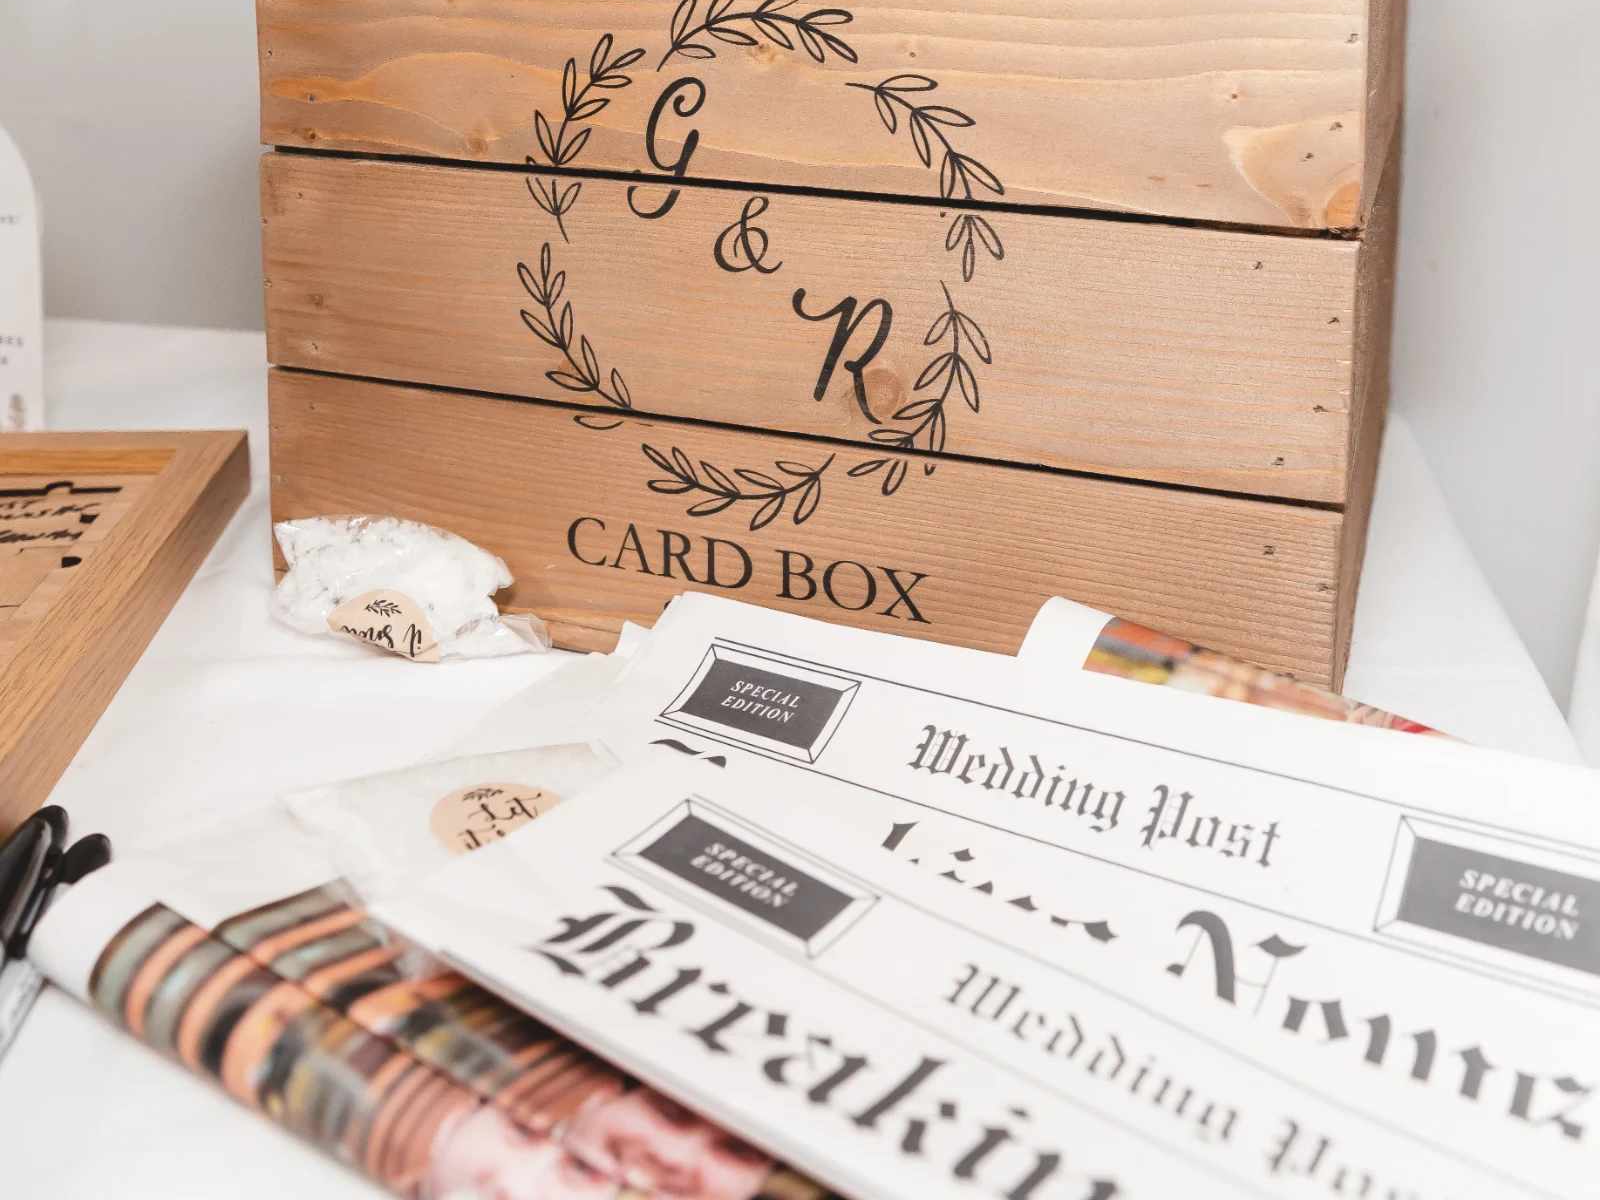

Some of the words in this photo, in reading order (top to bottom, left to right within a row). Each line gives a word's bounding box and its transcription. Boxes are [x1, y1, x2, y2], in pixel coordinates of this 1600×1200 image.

[627, 76, 707, 220] G
[713, 196, 783, 274] &
[792, 286, 895, 425] R
[567, 517, 753, 589] CARD
[775, 549, 931, 625] BOX
[721, 695, 794, 723] EDITION
[730, 679, 801, 709] SPECIAL
[907, 724, 1127, 833] Wedding
[1140, 783, 1281, 868] Post
[690, 854, 788, 908] EDITION
[704, 842, 798, 897] SPECIAL
[1458, 868, 1580, 917] SPECIAL
[1454, 891, 1581, 941] EDITION
[943, 962, 1241, 1145] Wedding
